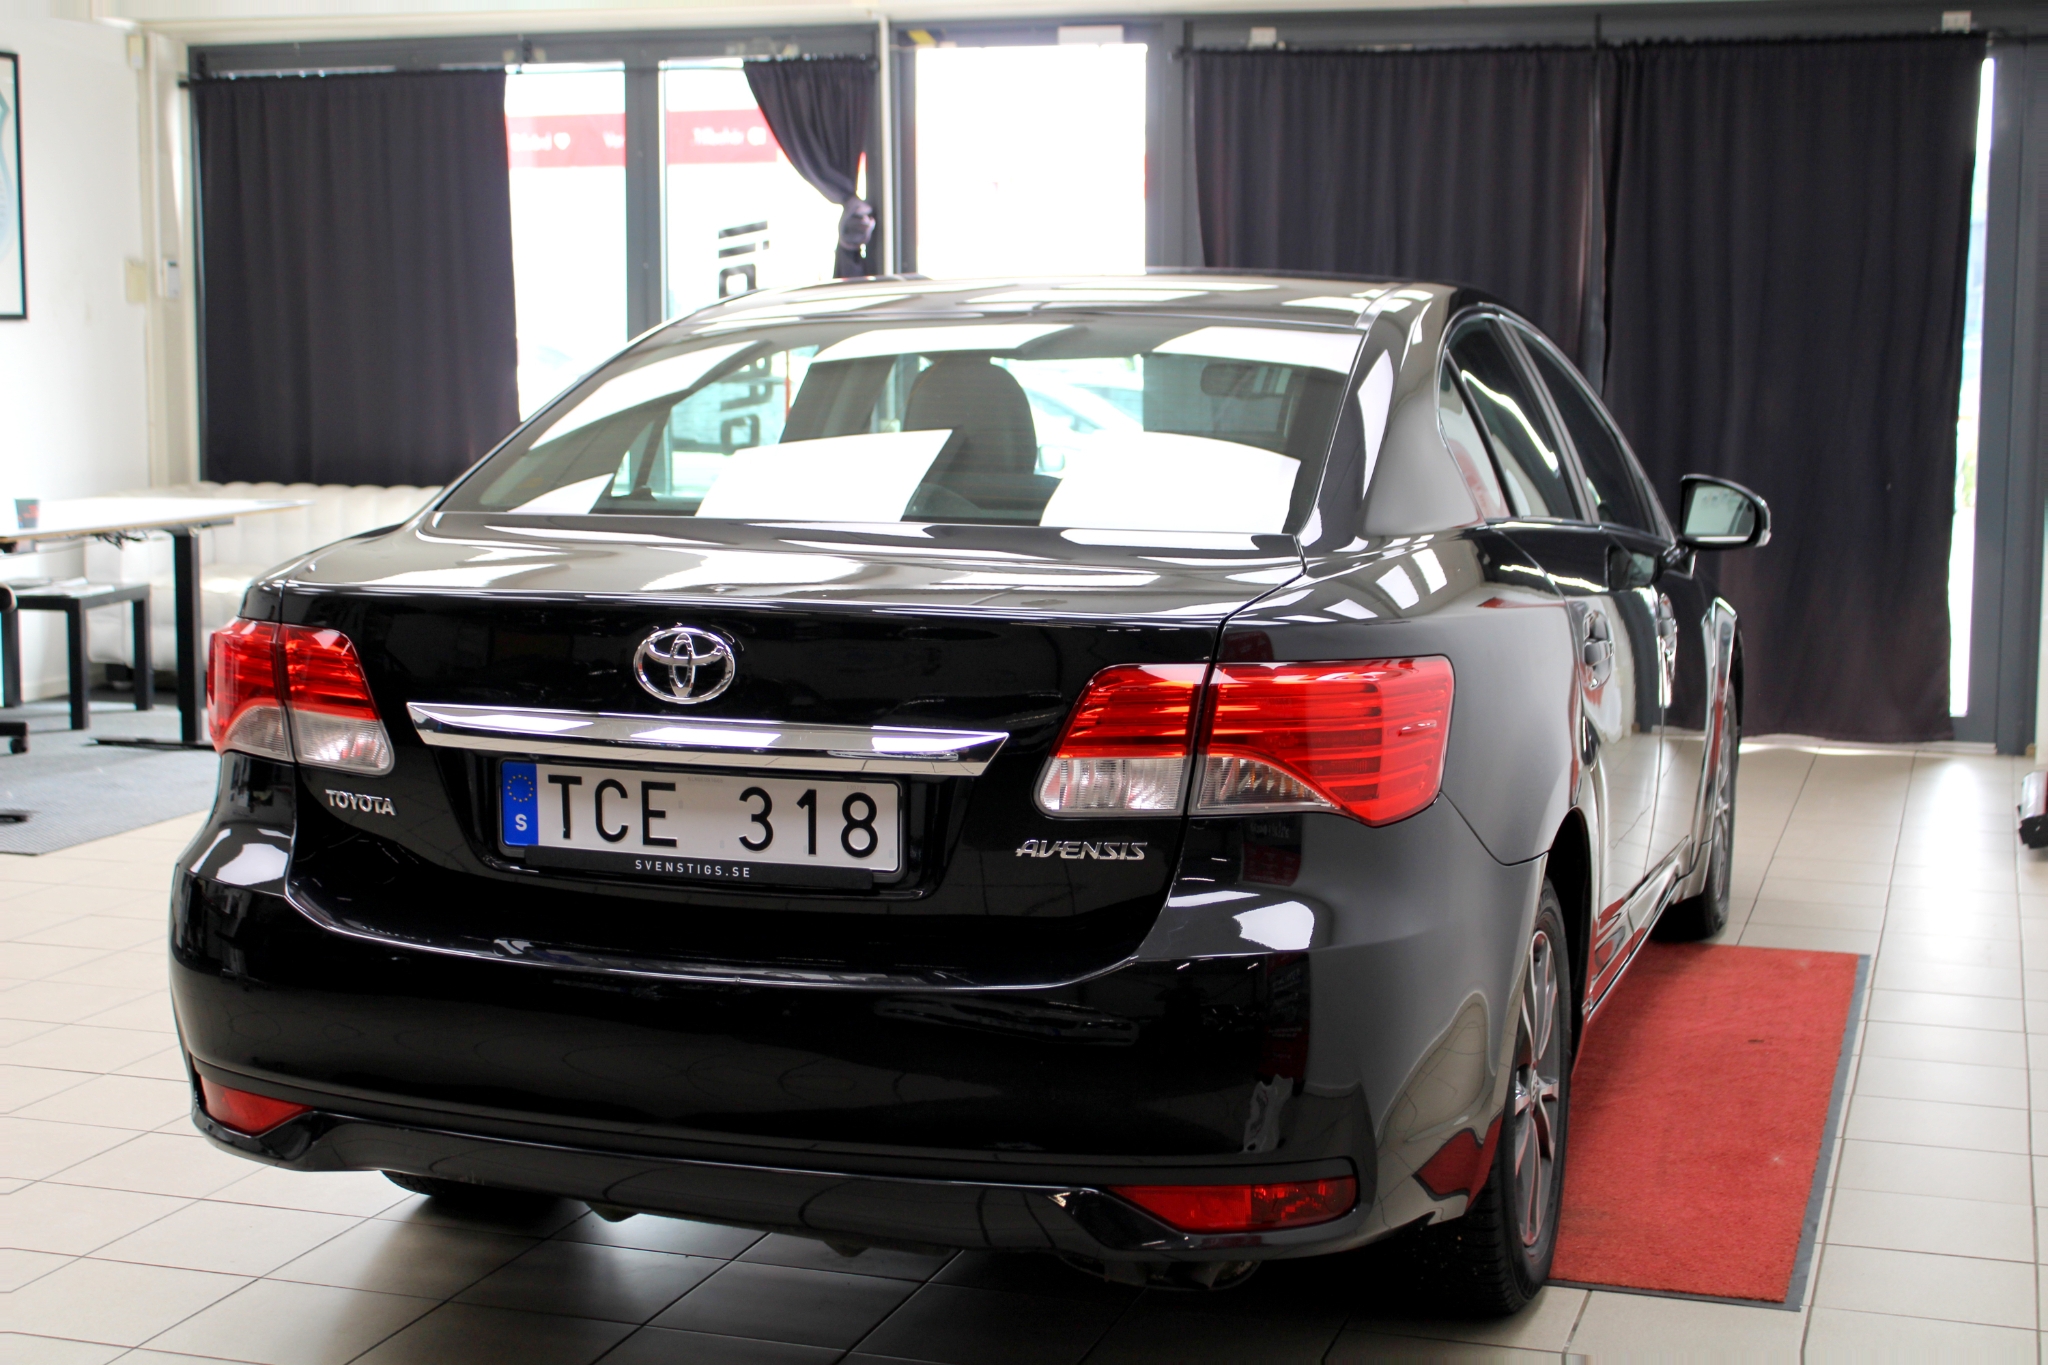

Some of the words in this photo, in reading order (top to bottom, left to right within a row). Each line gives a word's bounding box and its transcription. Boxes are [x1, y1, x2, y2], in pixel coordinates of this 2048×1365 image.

[325, 789, 397, 816] TOYOTA
[515, 813, 528, 832] S
[547, 774, 678, 848] TCE
[738, 786, 879, 859] 318
[1015, 839, 1148, 860] AVENSIS
[635, 859, 751, 878] SVENSTIGS.SE
